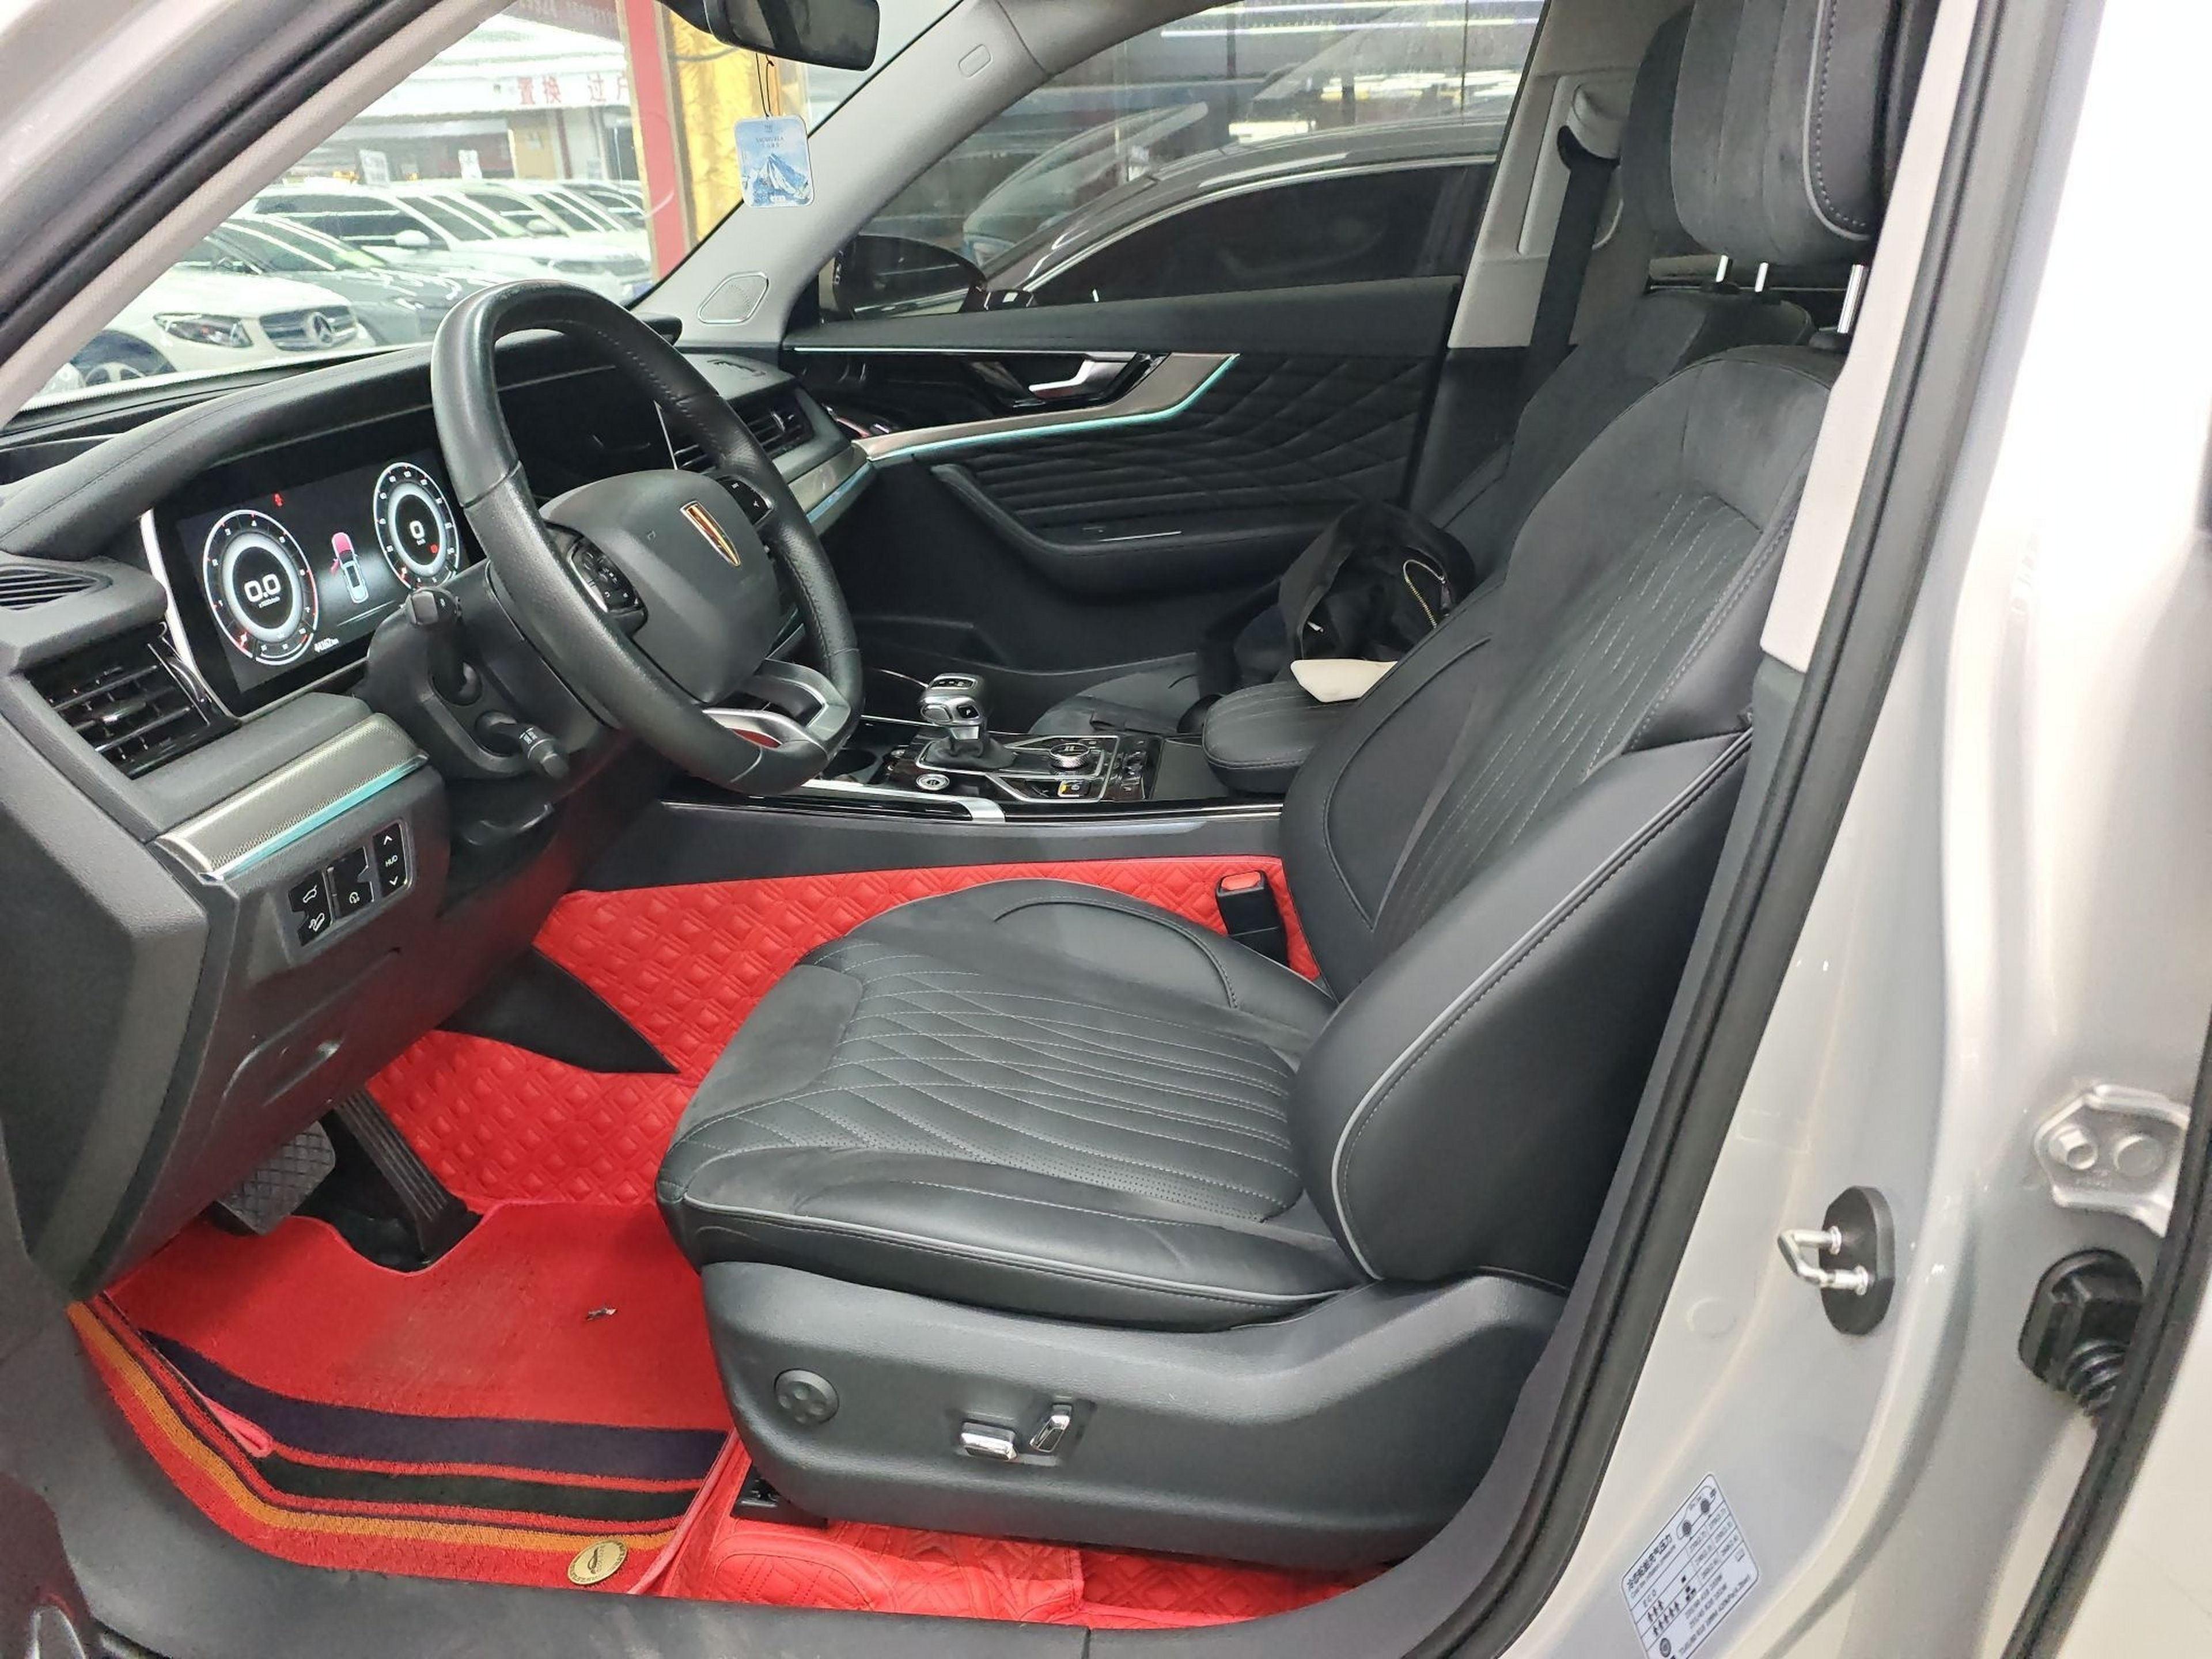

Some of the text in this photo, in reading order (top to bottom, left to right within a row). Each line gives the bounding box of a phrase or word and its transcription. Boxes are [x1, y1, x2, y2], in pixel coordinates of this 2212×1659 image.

[410, 520, 425, 539] 0
[244, 574, 281, 603] 0.0
[385, 855, 398, 867] HUD
